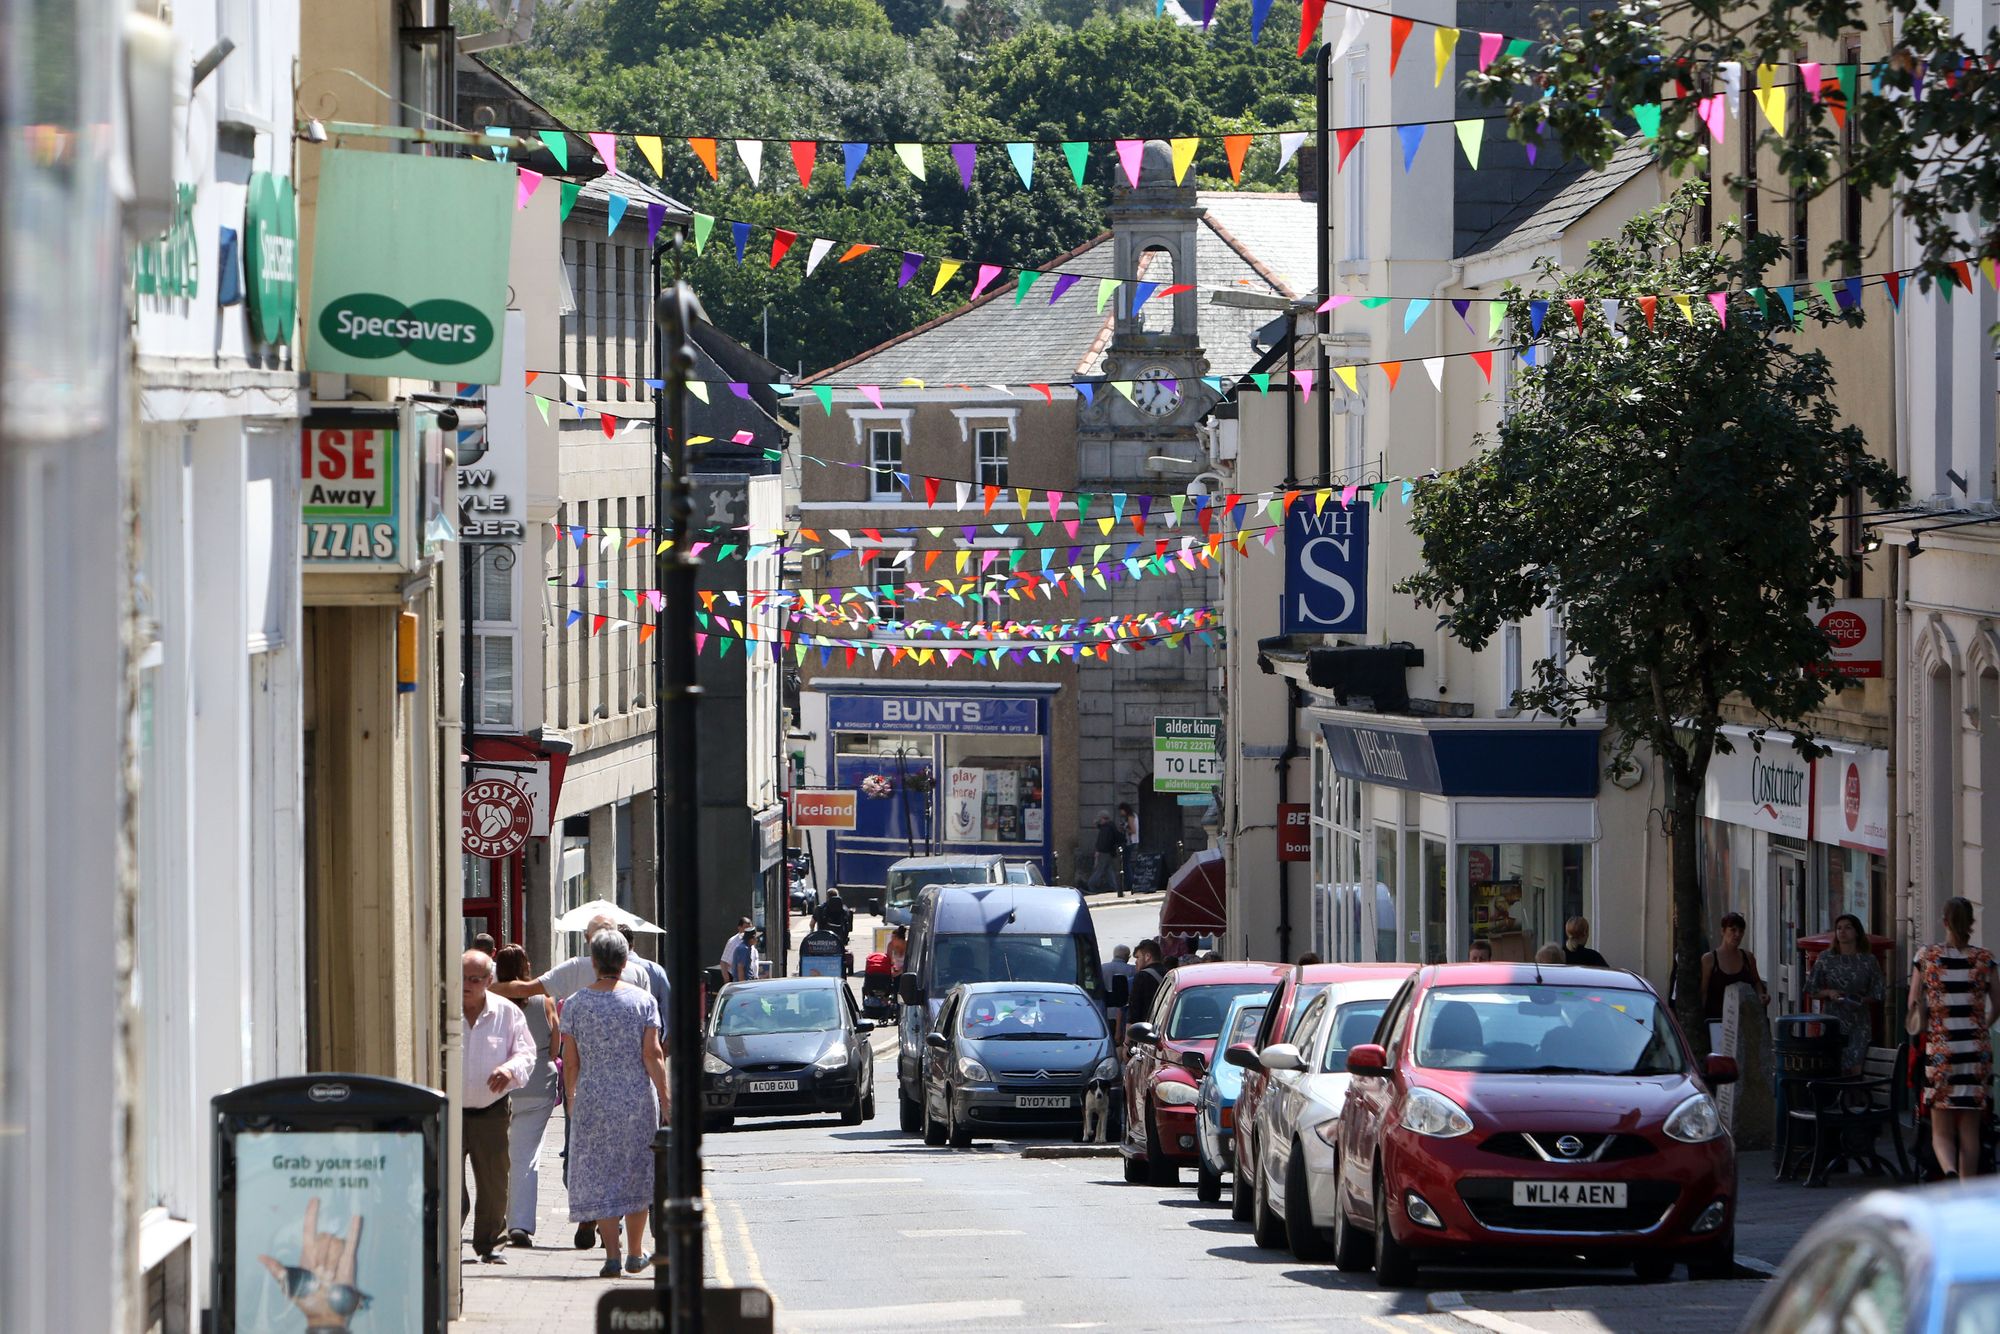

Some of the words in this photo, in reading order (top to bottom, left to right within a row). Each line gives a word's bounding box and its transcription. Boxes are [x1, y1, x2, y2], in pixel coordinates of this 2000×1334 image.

[337, 310, 476, 344] Specsavers
[309, 484, 376, 509] Away
[1297, 511, 1354, 535] WH
[1299, 537, 1355, 624] S
[1829, 618, 1856, 628] POST
[1825, 629, 1861, 639] FFICE
[883, 700, 980, 722] BUNTS
[1165, 720, 1192, 733] alder
[1194, 720, 1216, 737] king
[1165, 741, 1187, 750] 01872
[1353, 729, 1408, 781] WHSmith
[1166, 758, 1184, 773] TO
[1190, 759, 1217, 774] LET
[952, 769, 977, 785] play
[1752, 755, 1804, 807] Costcutter
[467, 785, 520, 810] COSTA
[952, 787, 977, 800] here!
[798, 804, 853, 816] Iceland
[461, 826, 522, 855] COFFEE
[753, 1082, 776, 1091] AC08
[777, 1081, 795, 1090] GXU
[1020, 1097, 1046, 1107] DY07
[1047, 1097, 1067, 1107] KYT
[272, 1155, 311, 1171] Grab
[316, 1155, 387, 1173] yourself
[290, 1177, 334, 1189] some
[339, 1177, 369, 1189] sun
[1526, 1184, 1569, 1204] WL14
[1576, 1185, 1615, 1204] AEN
[610, 1306, 665, 1331] fresh
